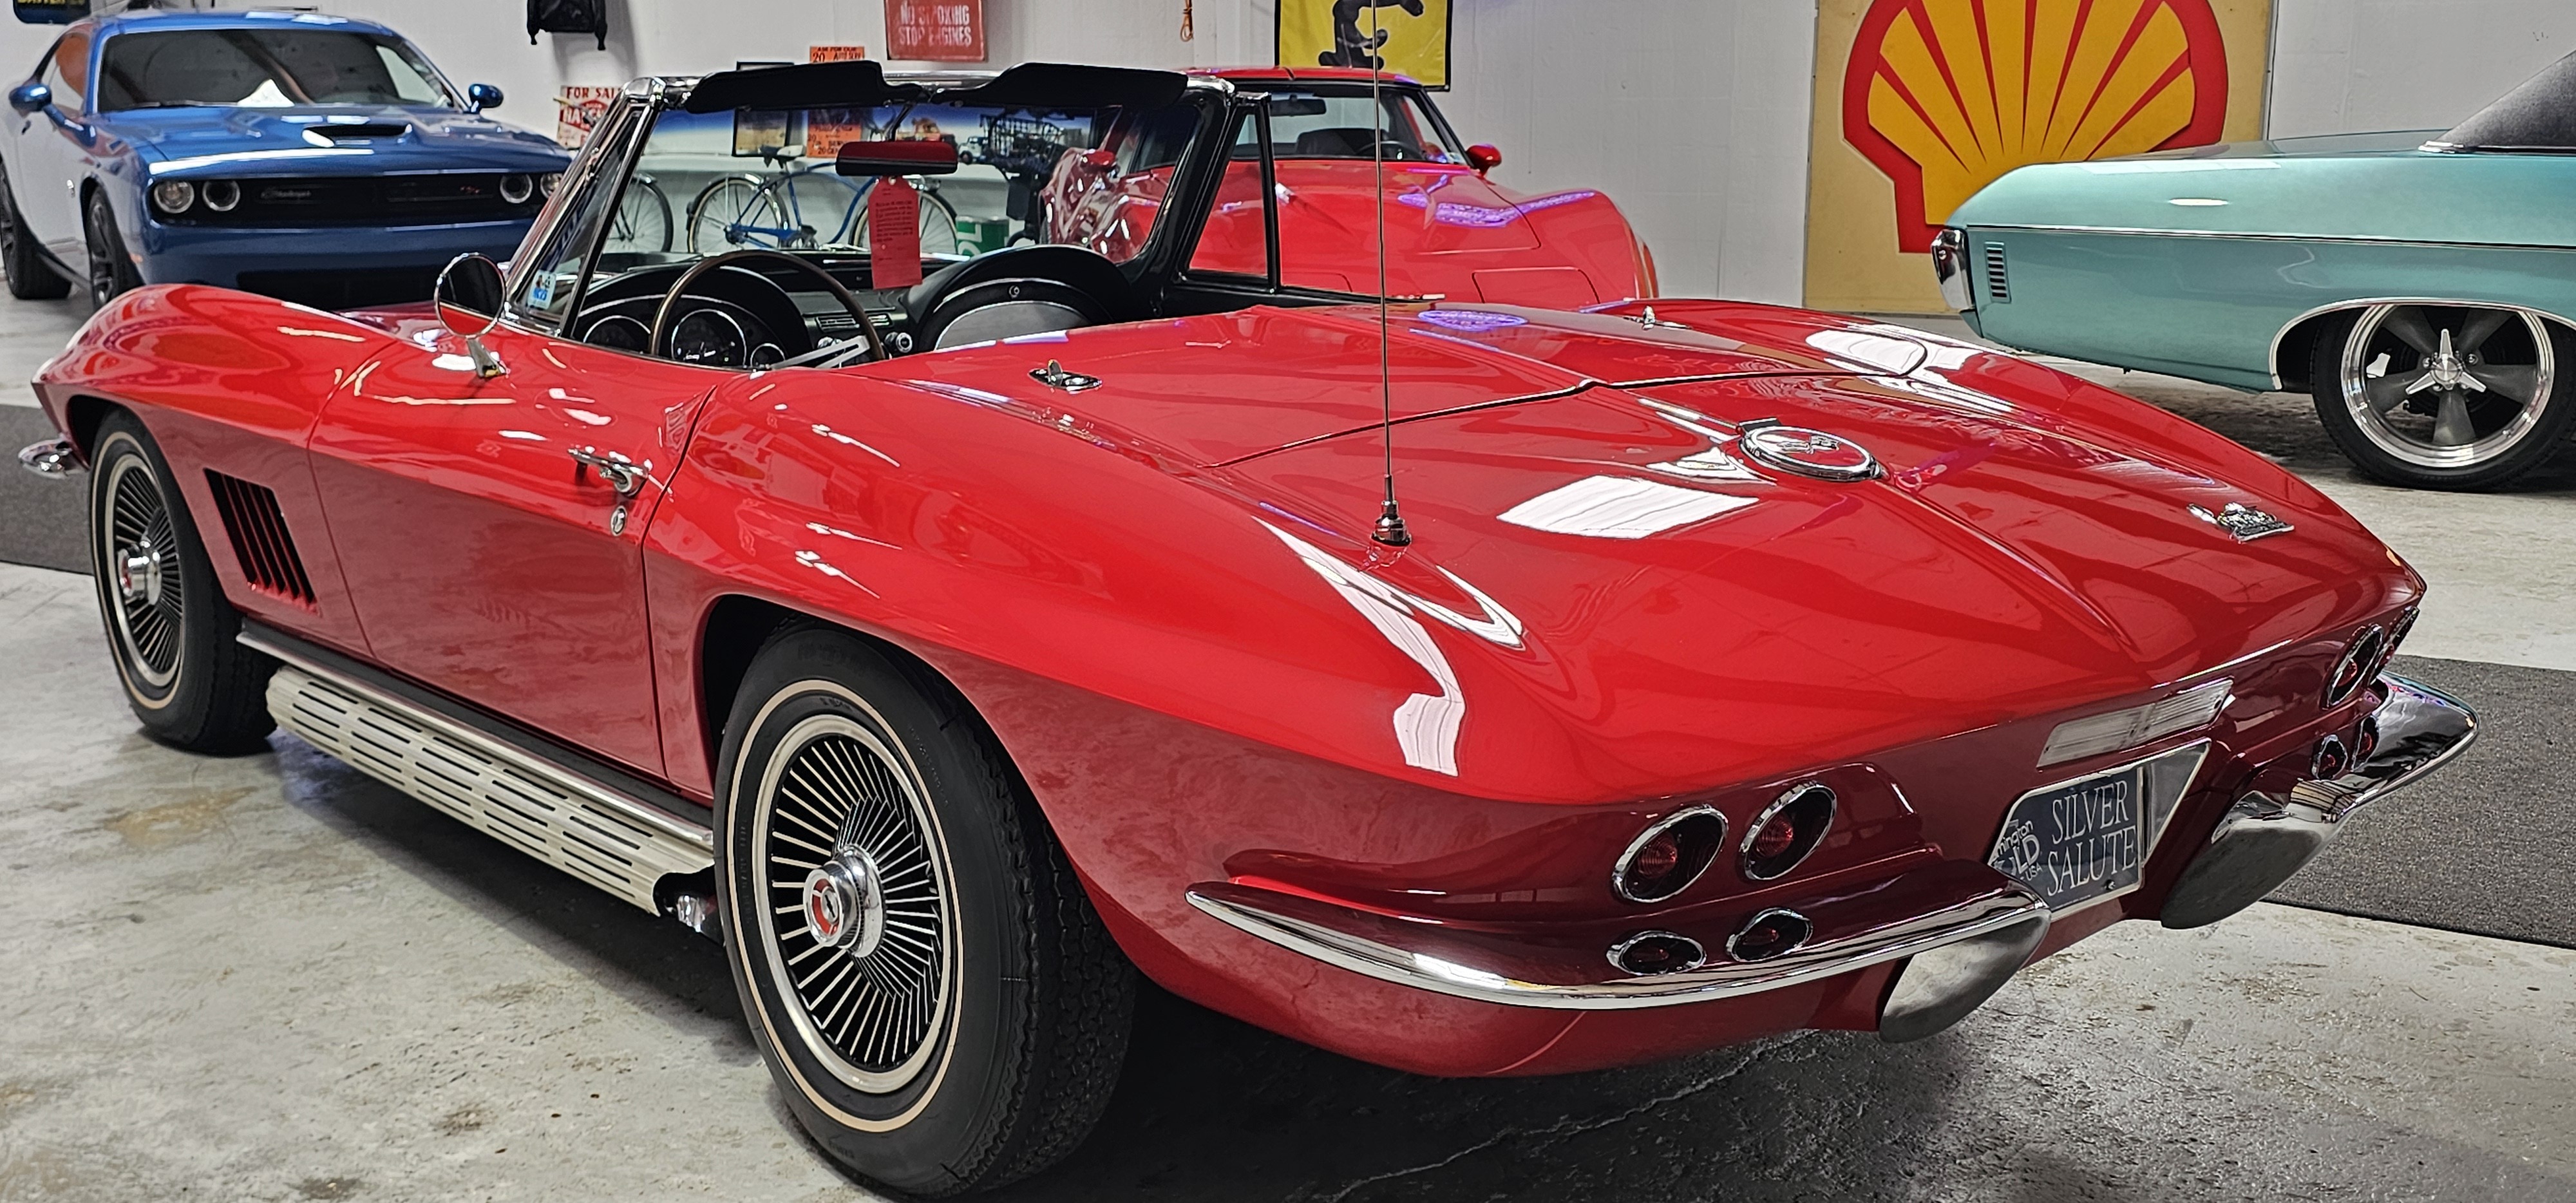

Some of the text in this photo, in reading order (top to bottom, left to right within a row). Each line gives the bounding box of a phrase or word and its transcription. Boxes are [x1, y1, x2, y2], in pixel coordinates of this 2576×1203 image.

[900, 2, 915, 25] NO
[898, 26, 925, 46] STOP
[566, 87, 622, 99] FOR SAL
[2052, 780, 2129, 845] SILVER
[2047, 825, 2136, 896] SALUTE
[2025, 862, 2043, 881] USA
